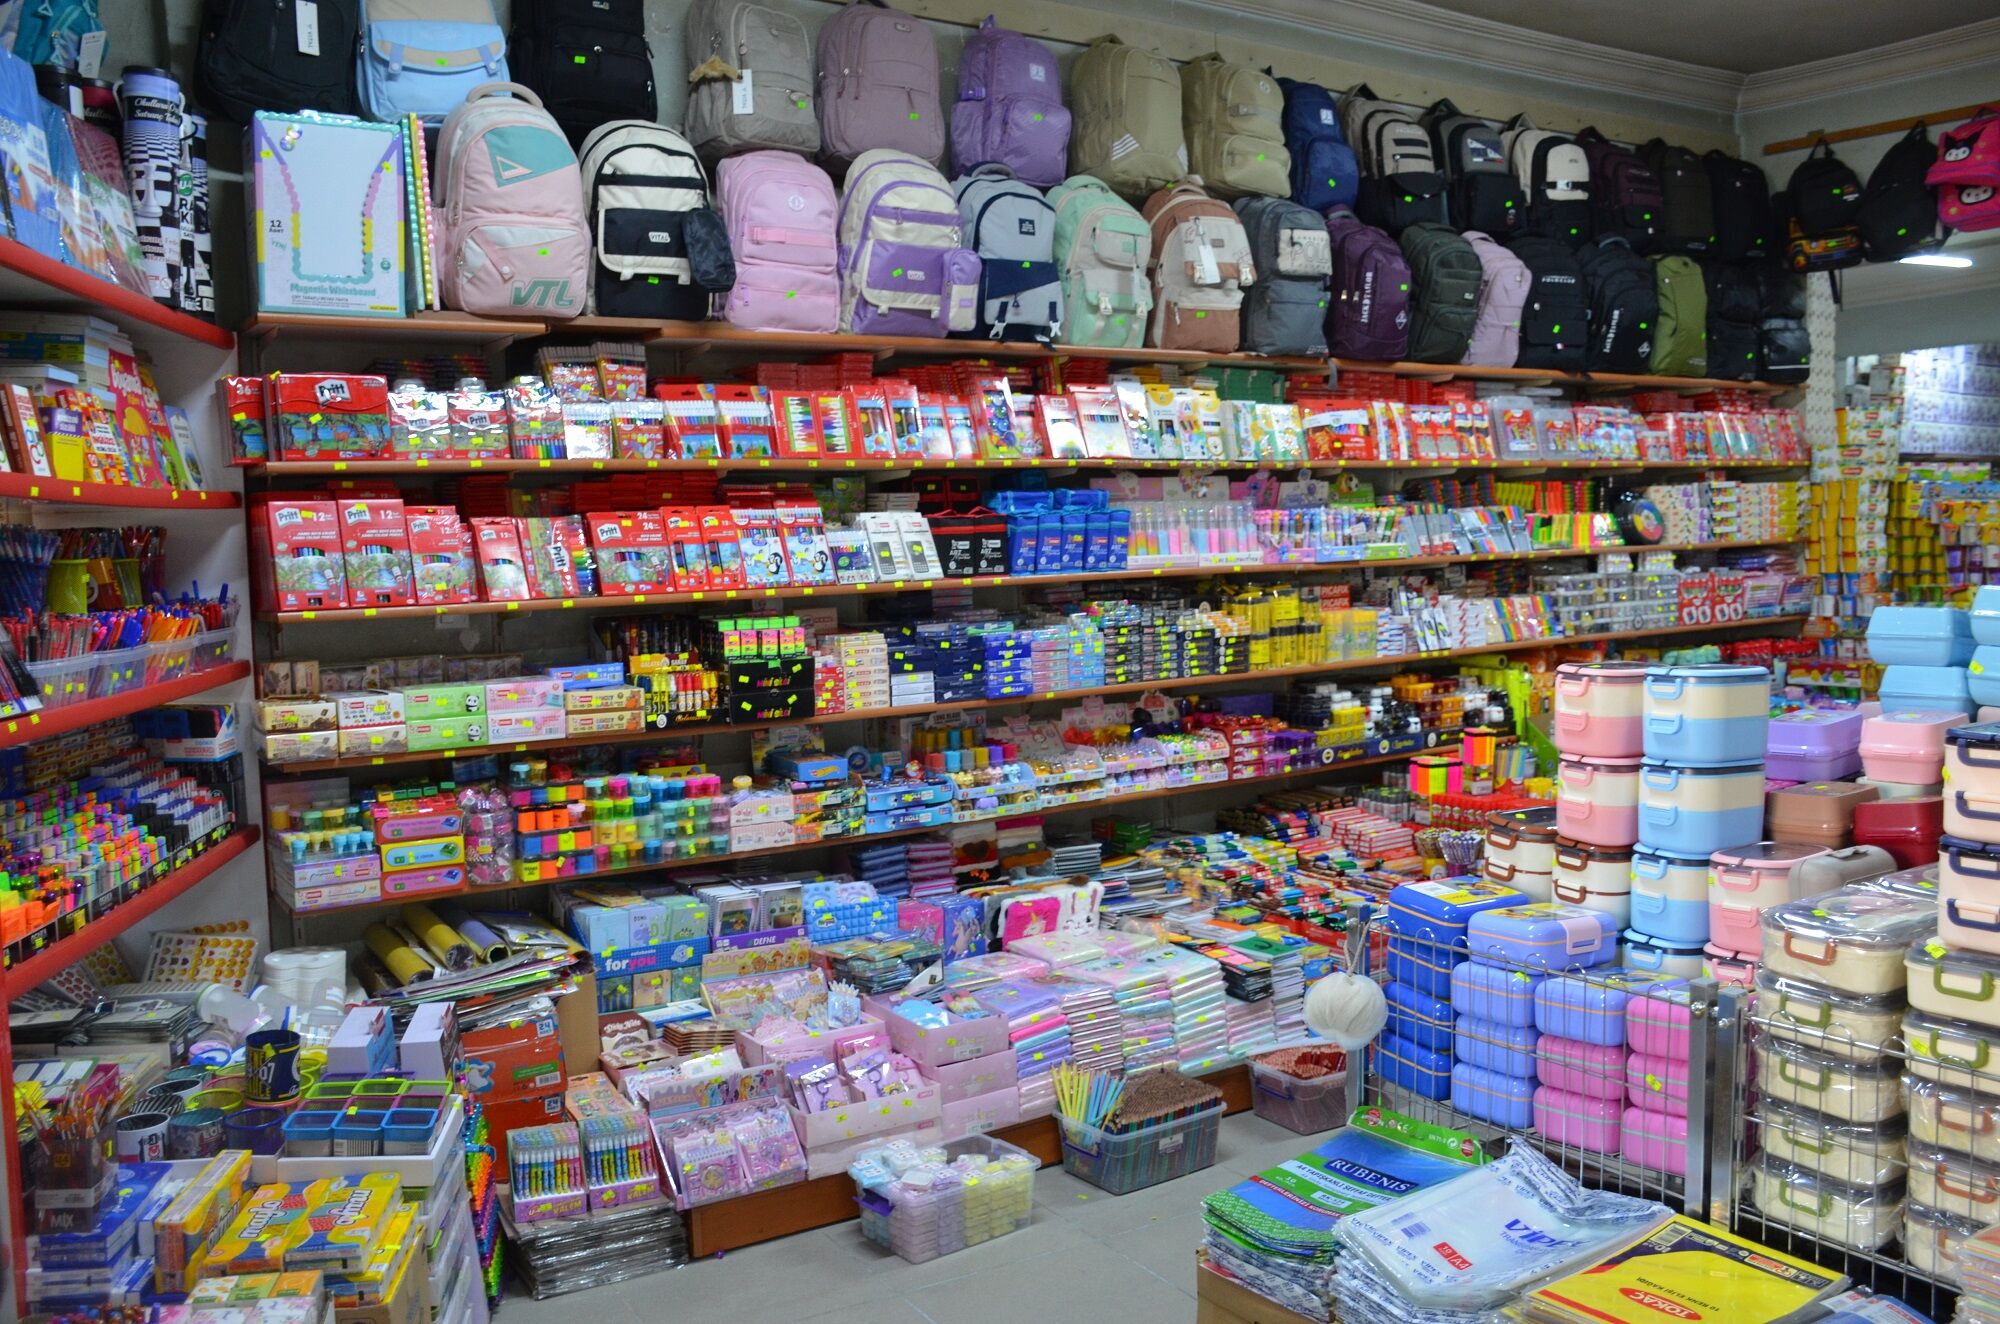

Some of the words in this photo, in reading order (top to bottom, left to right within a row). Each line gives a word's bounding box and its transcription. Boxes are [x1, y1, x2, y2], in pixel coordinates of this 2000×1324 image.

[270, 219, 282, 228] 12
[511, 278, 576, 307] VTL
[237, 384, 251, 396] 36
[318, 383, 345, 399] Pritt
[469, 415, 487, 424] Pritt
[278, 512, 298, 522] Pritt
[312, 511, 326, 522] 12
[346, 509, 367, 521] Pritt
[380, 509, 394, 520] 12
[412, 521, 427, 530] Pritt
[643, 522, 654, 530] 24
[599, 528, 618, 538] Pritt
[552, 546, 566, 568] Pritt
[754, 935, 776, 946] DEFNE
[539, 1022, 550, 1031] 24
[1329, 1158, 1410, 1193] RUBENIS
[51, 1213, 75, 1228] MIX
[1451, 1255, 1470, 1269] A4
[1630, 1290, 1690, 1318] TOKAÇ
[1686, 1296, 1710, 1308] RENK
